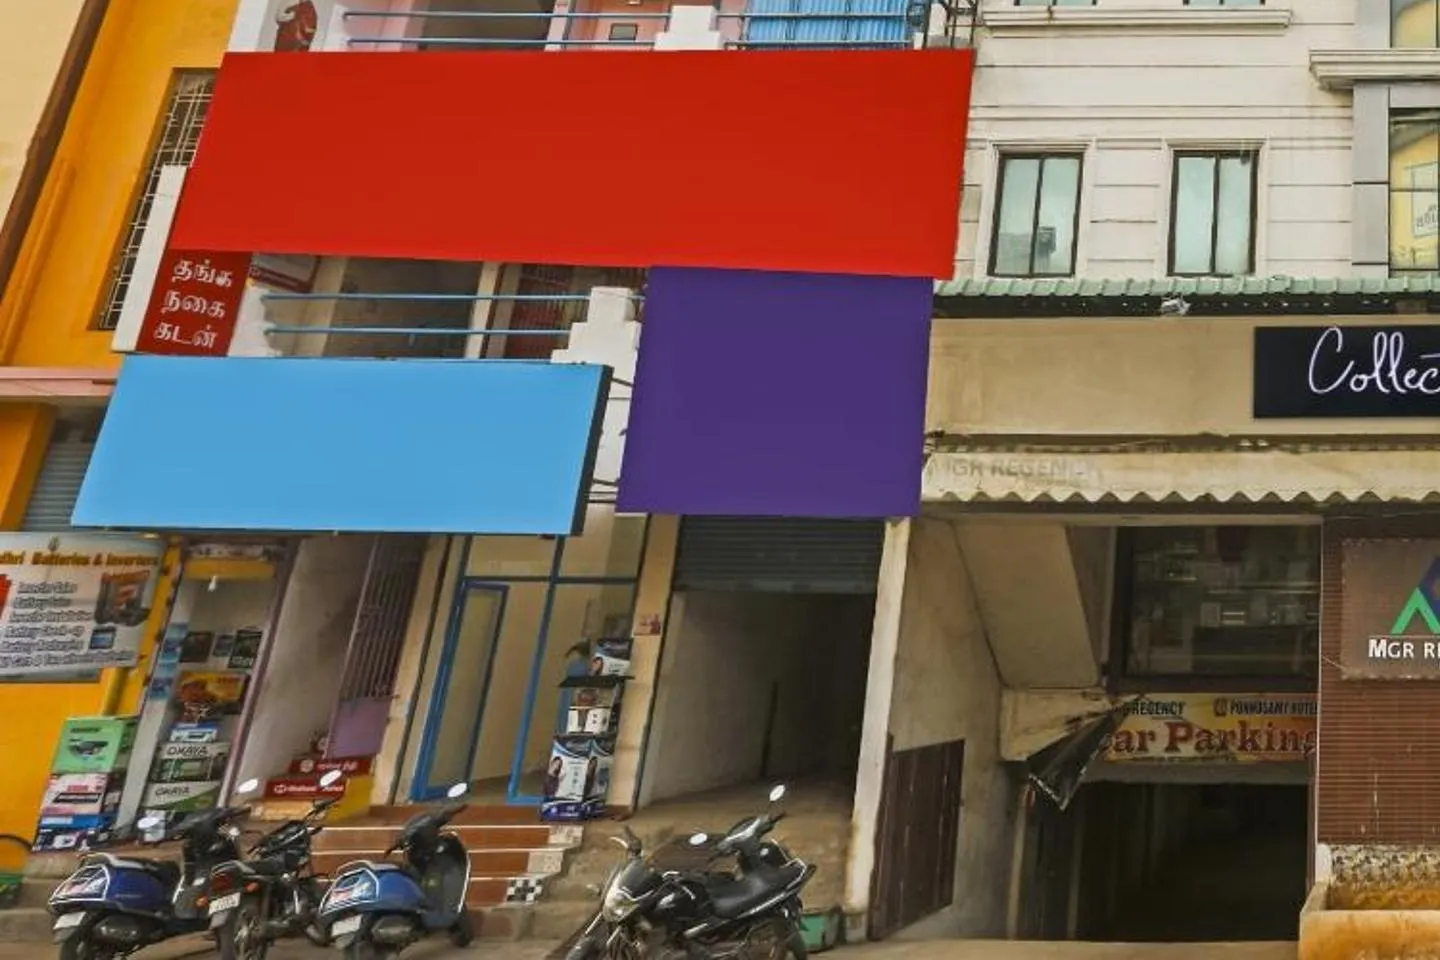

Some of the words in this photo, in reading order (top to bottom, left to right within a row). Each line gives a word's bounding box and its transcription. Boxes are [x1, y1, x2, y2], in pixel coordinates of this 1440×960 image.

[171, 258, 234, 288] தங்க
[160, 289, 226, 318] நகை
[153, 321, 219, 348] கடன்
[1368, 639, 1415, 658] MGR
